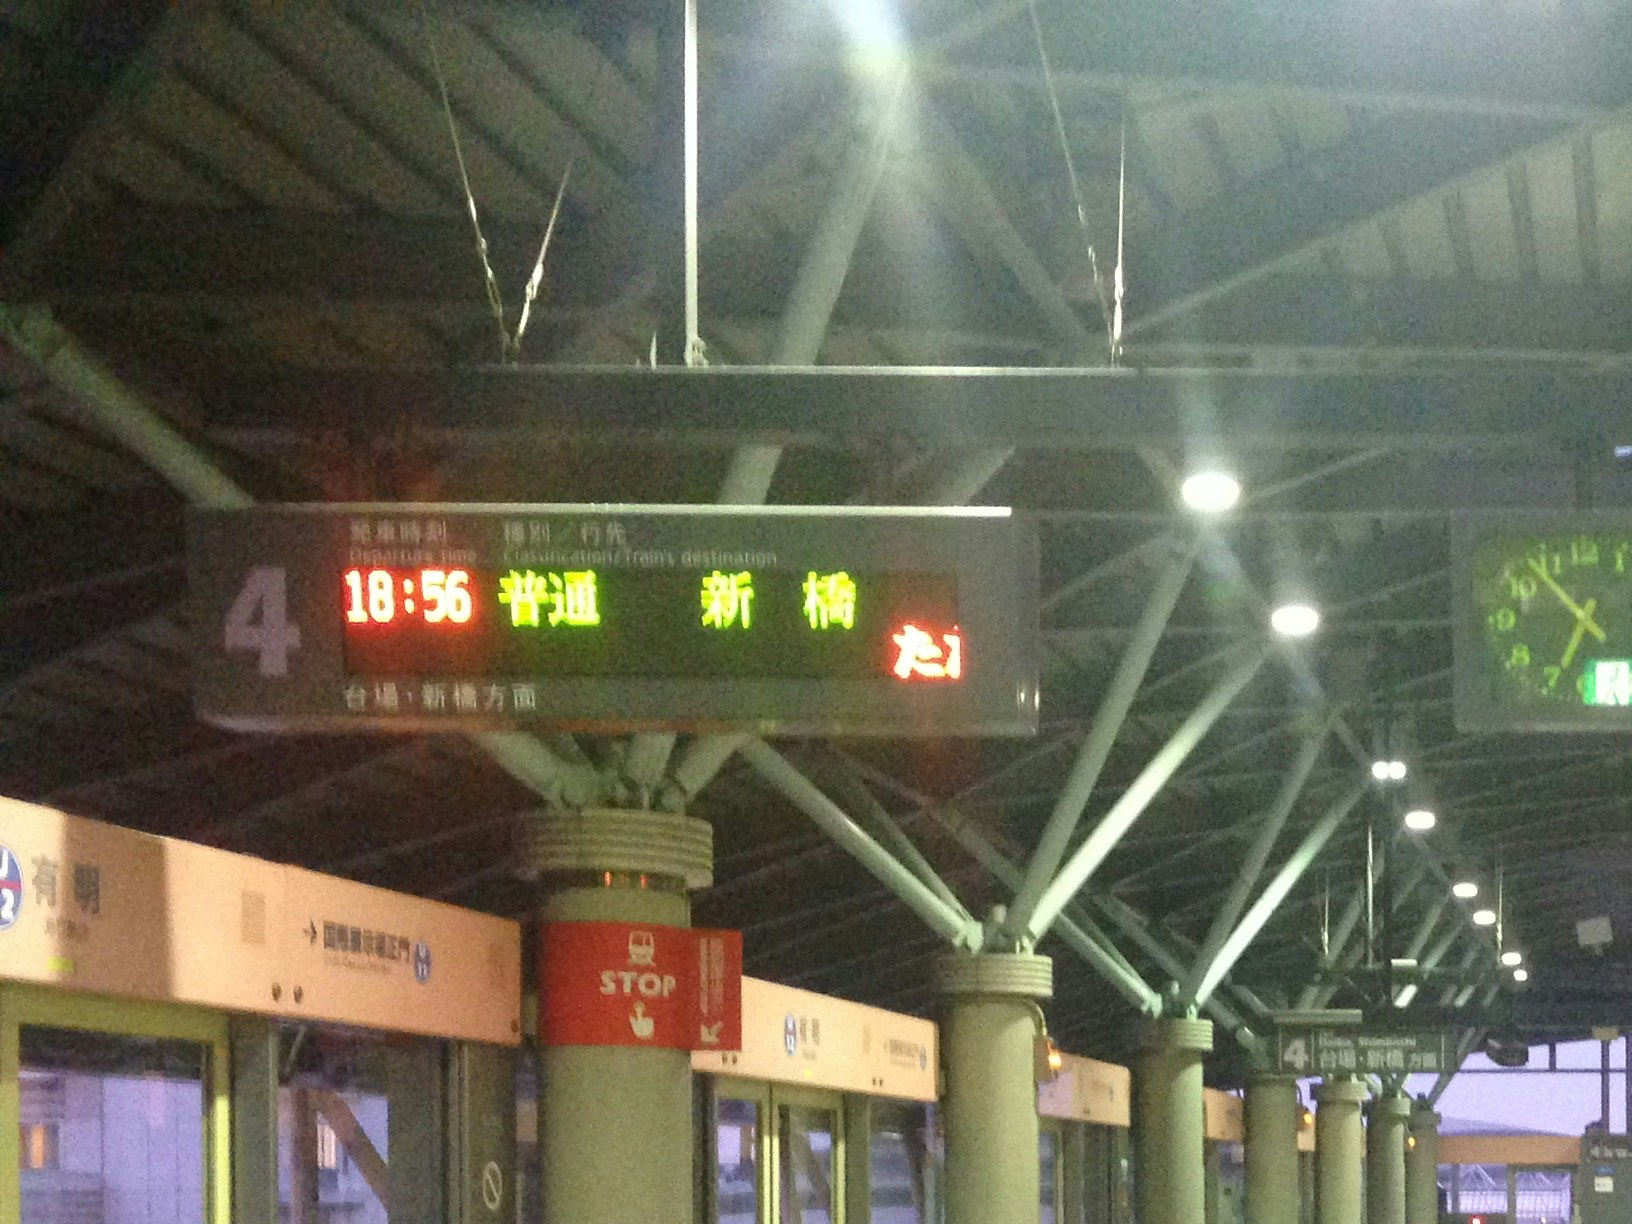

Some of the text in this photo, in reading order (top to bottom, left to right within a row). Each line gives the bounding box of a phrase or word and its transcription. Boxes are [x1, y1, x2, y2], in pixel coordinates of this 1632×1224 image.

[440, 548, 477, 563] time
[345, 569, 472, 624] 18:56
[498, 569, 601, 627] 普通
[225, 566, 300, 676] 4
[600, 970, 677, 998] STOP
[1284, 1038, 1309, 1070] 4
